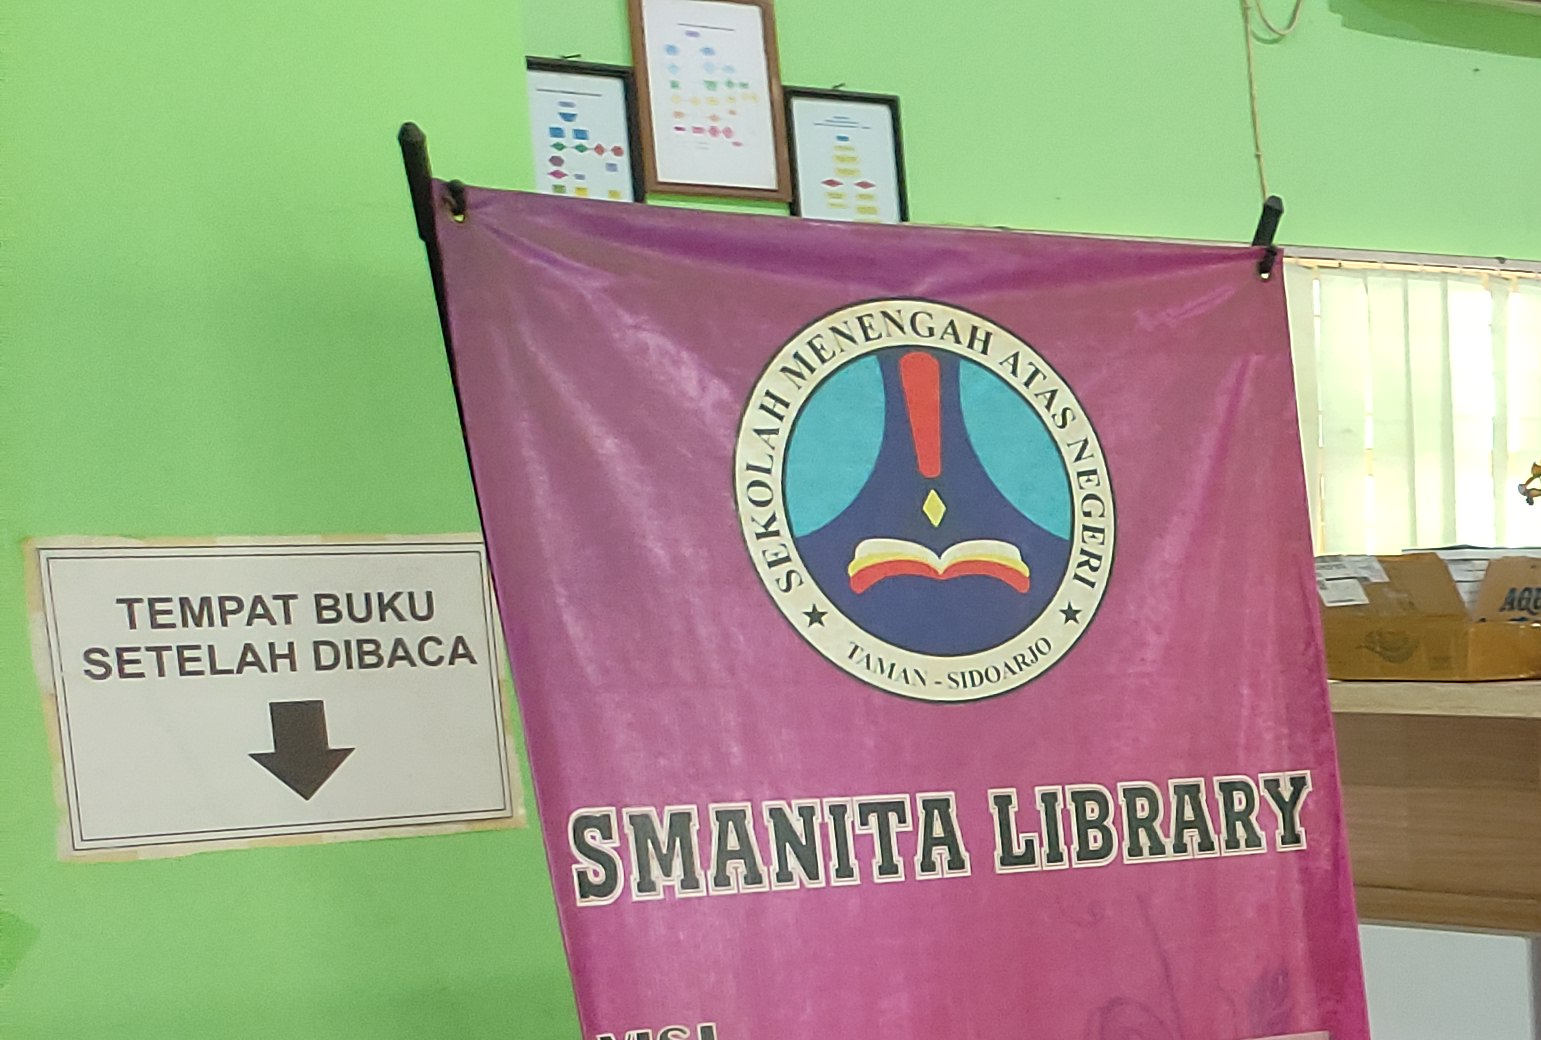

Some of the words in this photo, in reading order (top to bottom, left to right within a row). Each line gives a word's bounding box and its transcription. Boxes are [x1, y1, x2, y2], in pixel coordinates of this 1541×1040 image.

[746, 391, 804, 594] SEKOLAH
[780, 310, 993, 390] MENENGAH
[999, 350, 1077, 431] ATAS
[1066, 437, 1106, 590] NEGERI
[116, 593, 301, 631] TEMPAT
[313, 589, 437, 626] BUKU
[82, 640, 299, 681] SETELAH
[312, 634, 479, 674] DIBACA
[847, 642, 927, 687] TAMAN
[947, 637, 1053, 690] SIDOARJO
[570, 791, 972, 906] SMANITA
[990, 770, 1311, 875] LIBRARY
